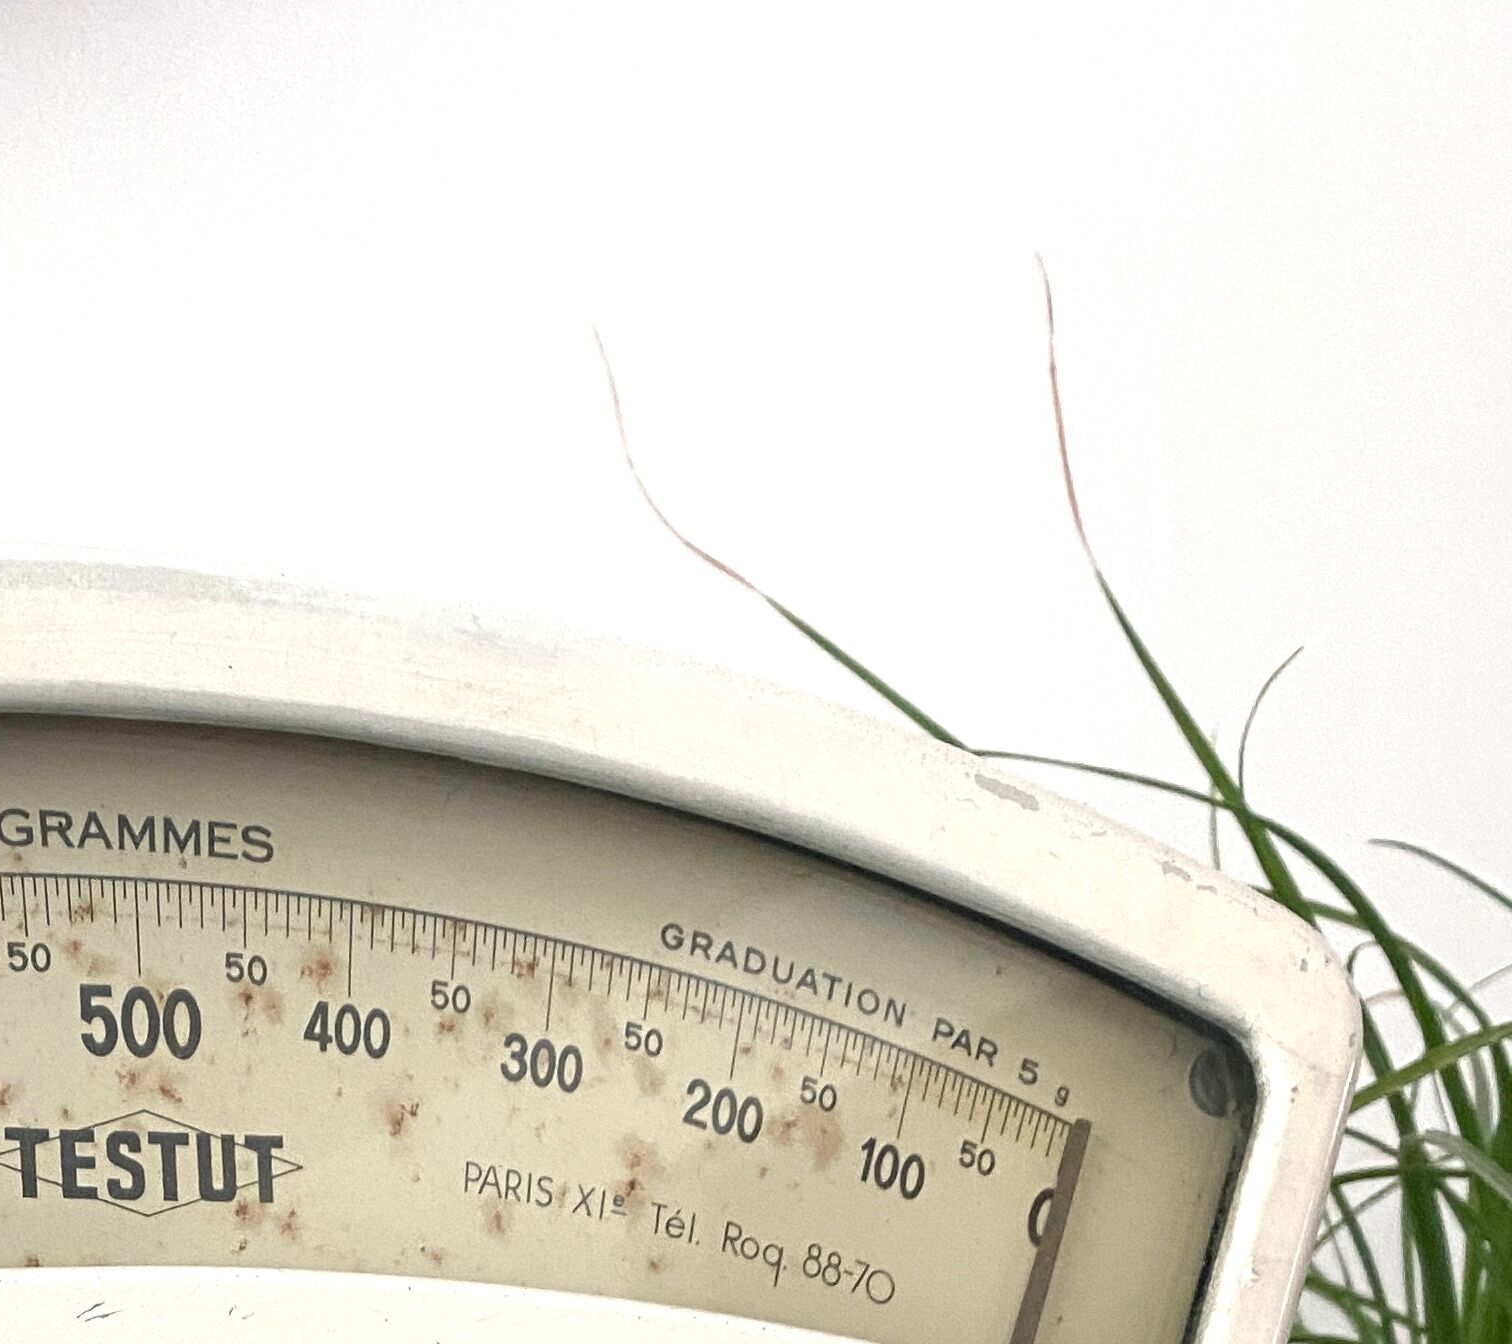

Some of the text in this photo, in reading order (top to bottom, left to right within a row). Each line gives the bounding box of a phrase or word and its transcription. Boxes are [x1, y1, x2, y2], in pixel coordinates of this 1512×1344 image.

[7, 941, 51, 973] 50
[79, 984, 202, 1060] 500
[225, 952, 268, 986] 50
[303, 1001, 390, 1059] 400
[431, 980, 472, 1014] 50
[500, 1034, 583, 1093] 300
[624, 1022, 664, 1058] 50
[683, 1079, 764, 1143] 200
[799, 1076, 838, 1112] 50
[859, 1136, 926, 1200] 100
[959, 1139, 996, 1176] 50
[660, 923, 1070, 1107] GRADUATION PAR 5 g
[4, 1126, 284, 1204] TESTUT
[463, 1161, 554, 1207] PARIS
[651, 1202, 699, 1246] Tél.
[721, 1220, 787, 1288] Roq.
[802, 1242, 895, 1305] 88-70
